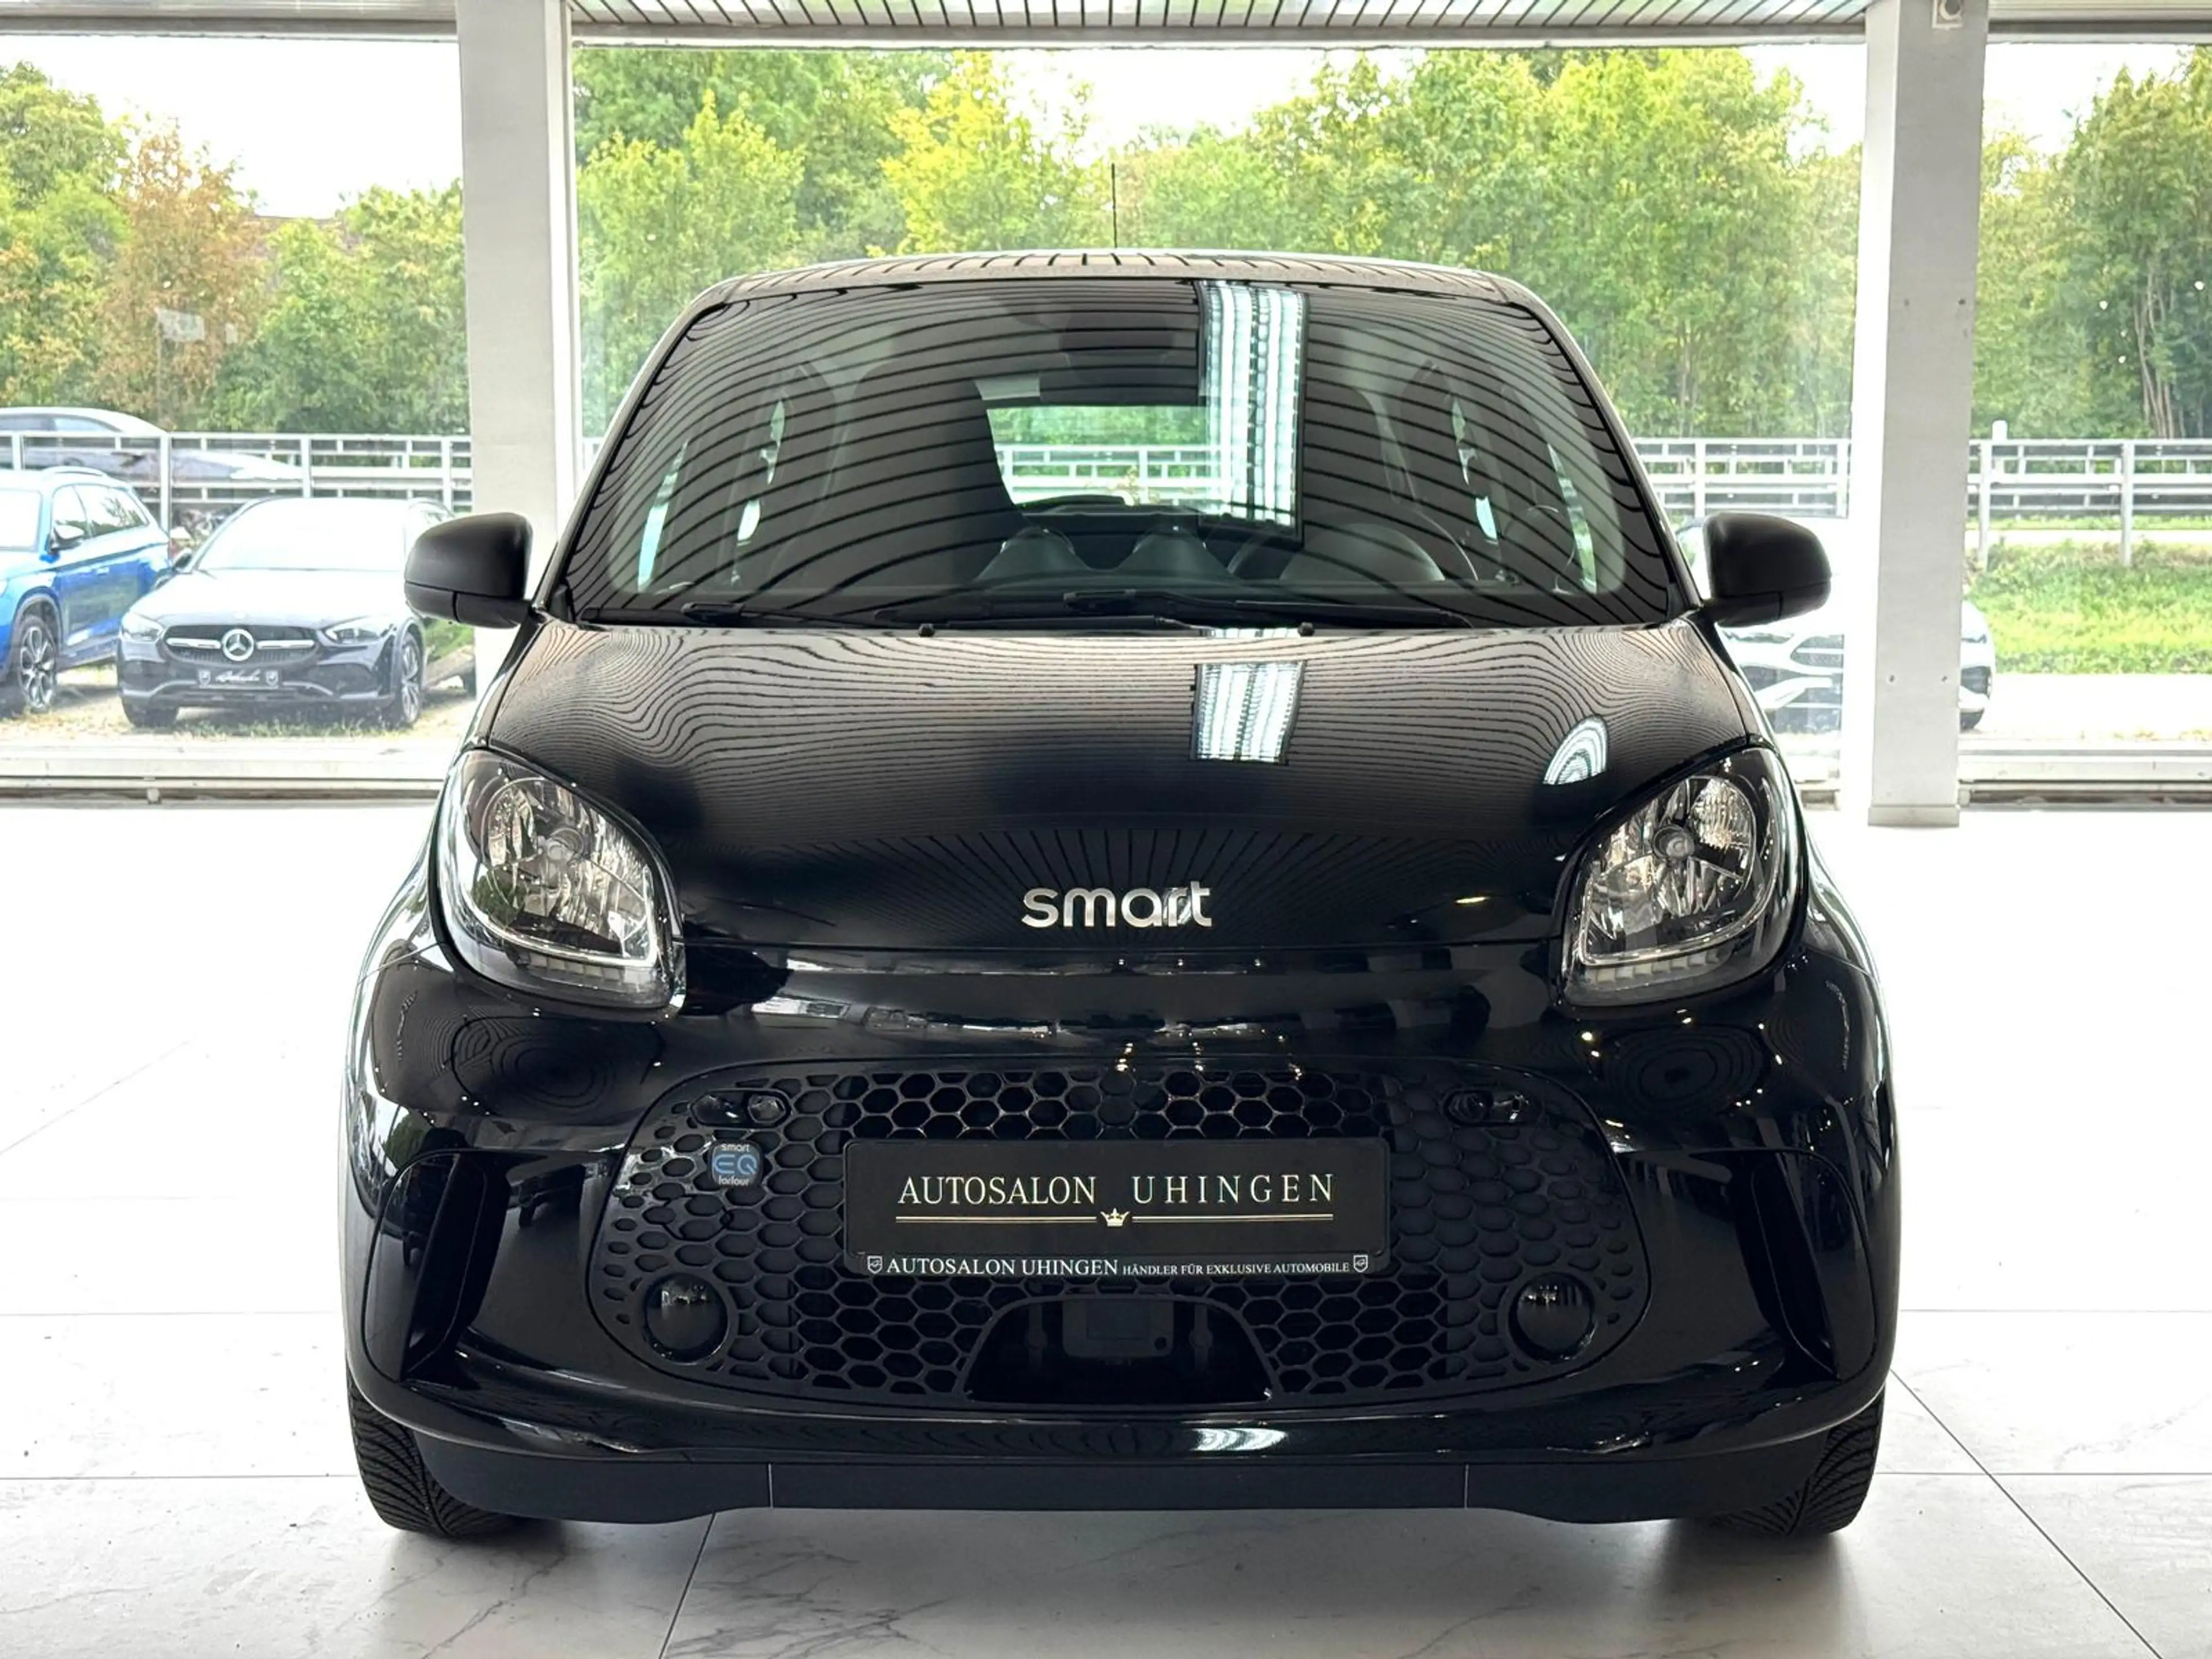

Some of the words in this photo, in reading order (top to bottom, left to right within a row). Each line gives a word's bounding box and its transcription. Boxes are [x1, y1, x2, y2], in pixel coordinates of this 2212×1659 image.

[1021, 881, 1212, 928] smart
[721, 1143, 750, 1152] smart
[714, 1154, 757, 1175] EQ
[897, 1176, 1096, 1205] AUTOSALON
[1132, 1173, 1334, 1204] UHINGEN
[887, 1257, 1016, 1275] AUTOSALON
[1021, 1259, 1118, 1275] UHINGEN
[1123, 1263, 1178, 1275] HÄNDLER
[1181, 1263, 1205, 1275] FÜR
[1207, 1264, 1271, 1275] EXKLUSIVE
[1273, 1262, 1350, 1273] AUTOMOBILE
